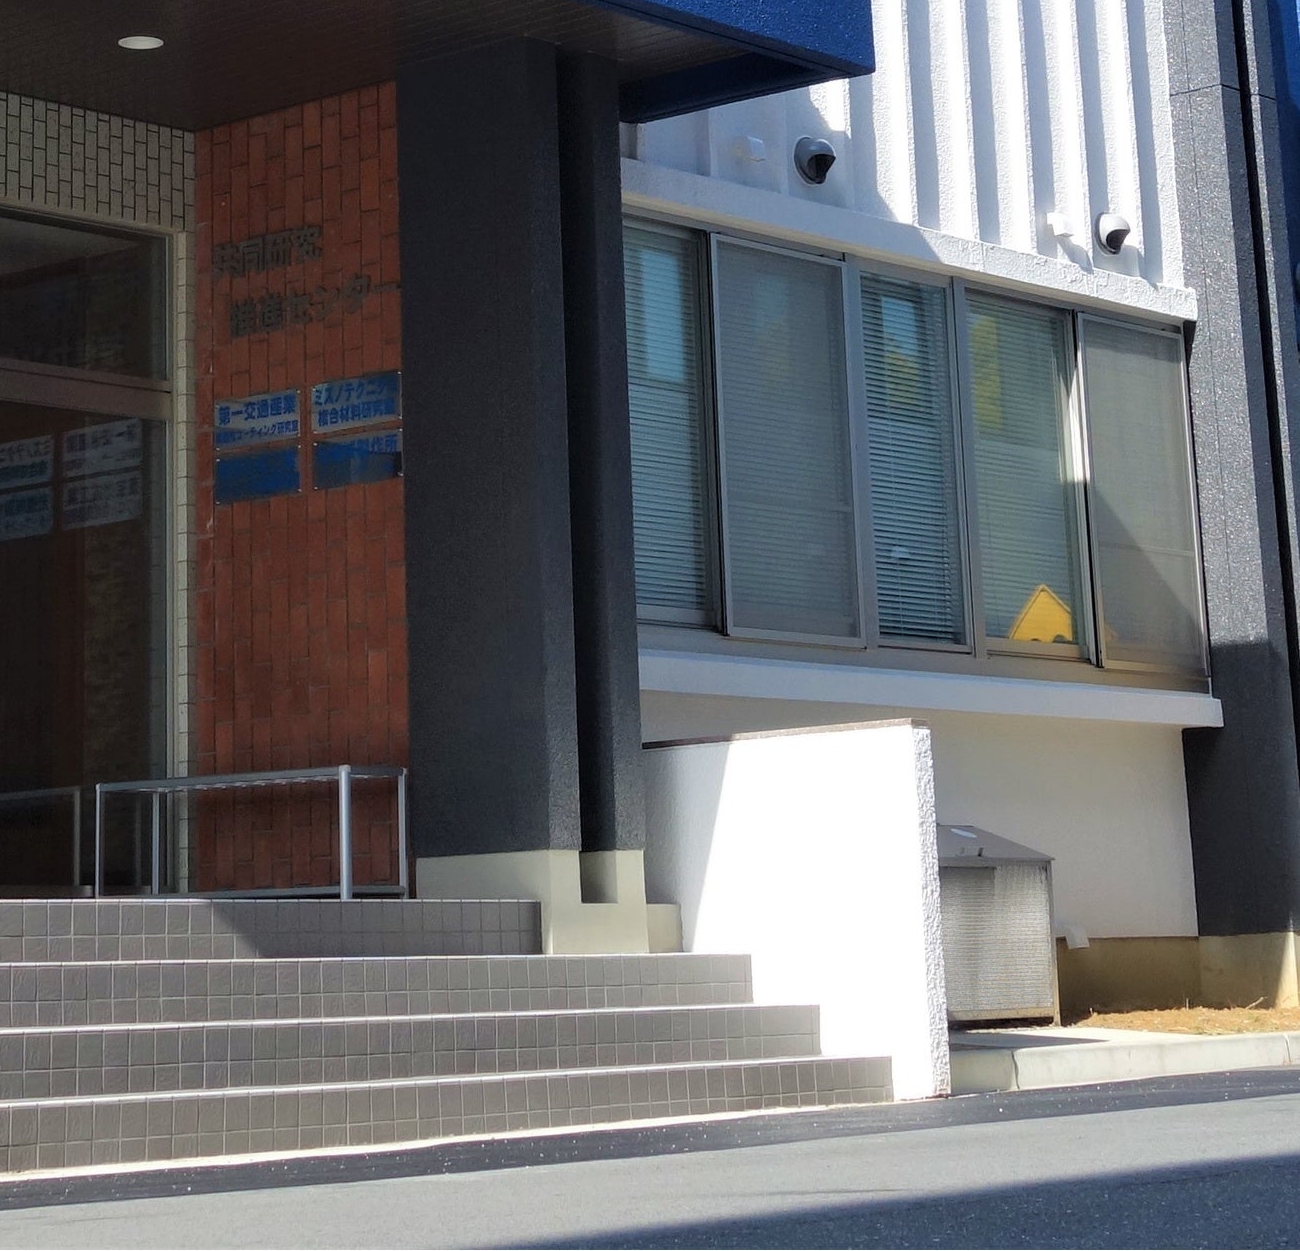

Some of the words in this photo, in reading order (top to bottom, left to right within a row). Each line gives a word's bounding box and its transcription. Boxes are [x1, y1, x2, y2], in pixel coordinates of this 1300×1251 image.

[218, 393, 296, 426] 第一交通産業
